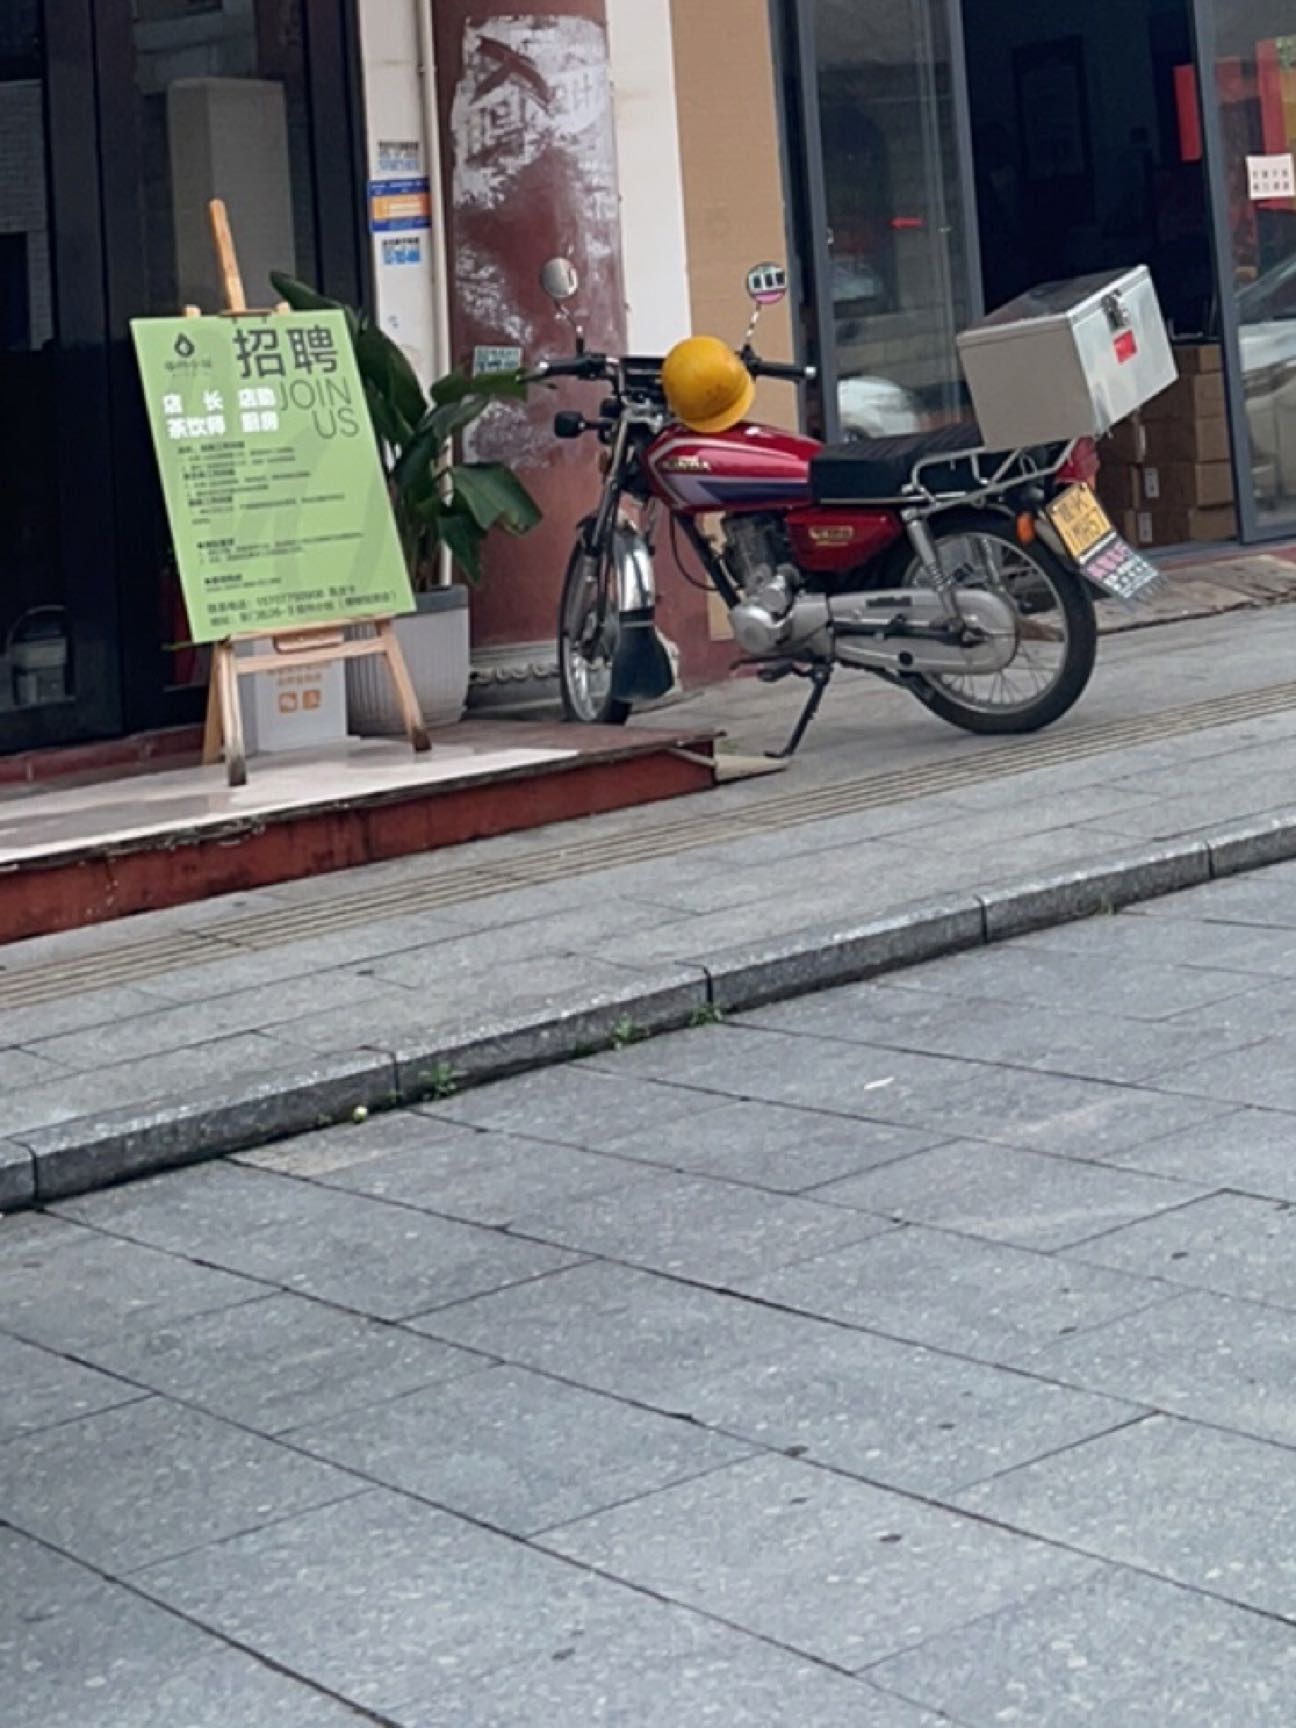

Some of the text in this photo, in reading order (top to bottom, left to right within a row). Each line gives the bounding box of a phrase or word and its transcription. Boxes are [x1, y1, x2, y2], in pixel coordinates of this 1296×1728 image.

[232, 323, 338, 379] 招聘
[280, 377, 352, 411] JOIN
[311, 407, 359, 440] US
